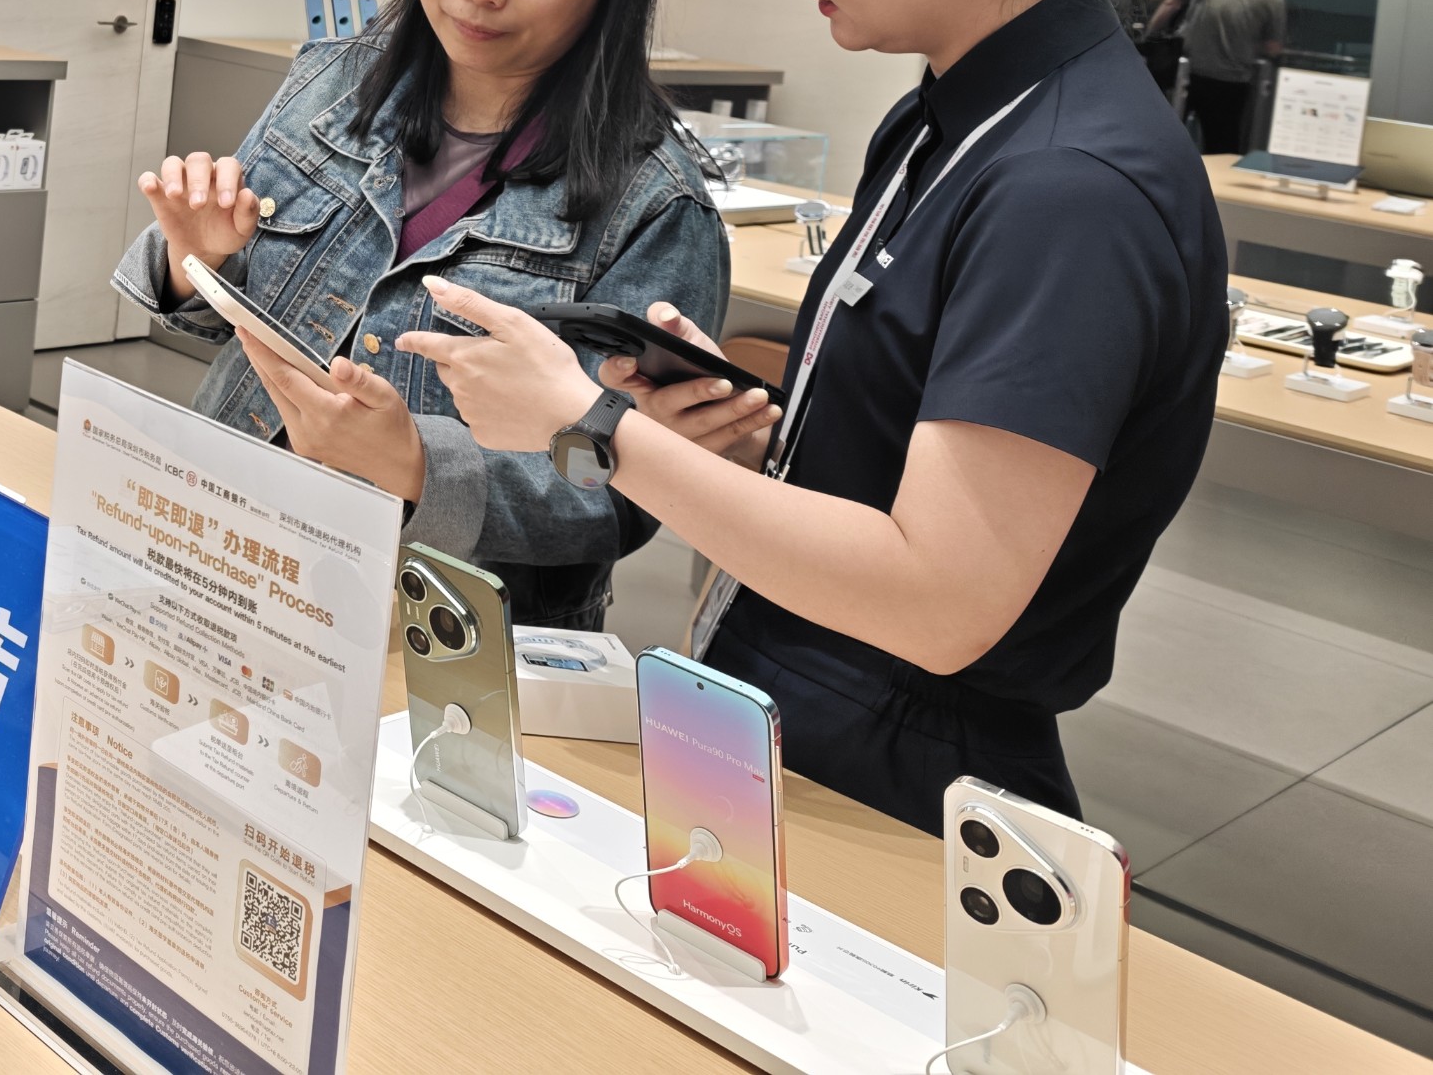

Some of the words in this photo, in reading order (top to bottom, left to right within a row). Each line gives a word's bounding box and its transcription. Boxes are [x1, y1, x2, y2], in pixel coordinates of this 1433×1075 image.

[125, 477, 218, 546] “即买即退”
[222, 526, 300, 585] 办理流程
[164, 462, 184, 479] ICBC
[200, 477, 247, 509] 中国工商银行
[279, 511, 361, 557] 深圳市离境退税代理机构
[91, 489, 264, 594] "Refund-upon-Purchase"
[268, 579, 334, 629] Process
[147, 547, 258, 615] 税款最快将在5分钟内到账
[76, 524, 86, 537] Tax
[87, 531, 108, 549] Refund
[109, 543, 131, 561] amount
[132, 554, 143, 568] will
[144, 561, 152, 573] be
[153, 566, 179, 588] credited
[180, 581, 187, 591] to
[188, 586, 203, 600] your
[205, 594, 232, 615] account
[233, 608, 254, 627] within
[256, 621, 261, 630] 5
[263, 623, 291, 646] minutes
[293, 640, 301, 650] at
[303, 644, 315, 658] the
[317, 651, 346, 673] earliest
[158, 593, 237, 644] 支持以下方式收取退税款项
[149, 601, 175, 622] Supported
[176, 615, 194, 631] Refund
[195, 626, 220, 646] Collection
[221, 640, 245, 659] Methods
[217, 653, 231, 667] VISA
[70, 710, 99, 738] 注意事项
[106, 734, 133, 760] Notice
[645, 716, 689, 742] HUAWEI
[692, 738, 724, 760] Pura90
[726, 753, 742, 767] Pro
[744, 761, 765, 779] Max
[244, 821, 316, 879] 扫码开始退税
[71, 925, 100, 955] Reminder
[683, 899, 742, 938] HarmonyOS
[43, 936, 61, 955] original
[155, 1023, 179, 1048] Customs
[180, 1044, 212, 1074] verification
[238, 983, 267, 1010] Customer
[269, 1007, 292, 1028] service
[900, 978, 923, 991] Kirin
